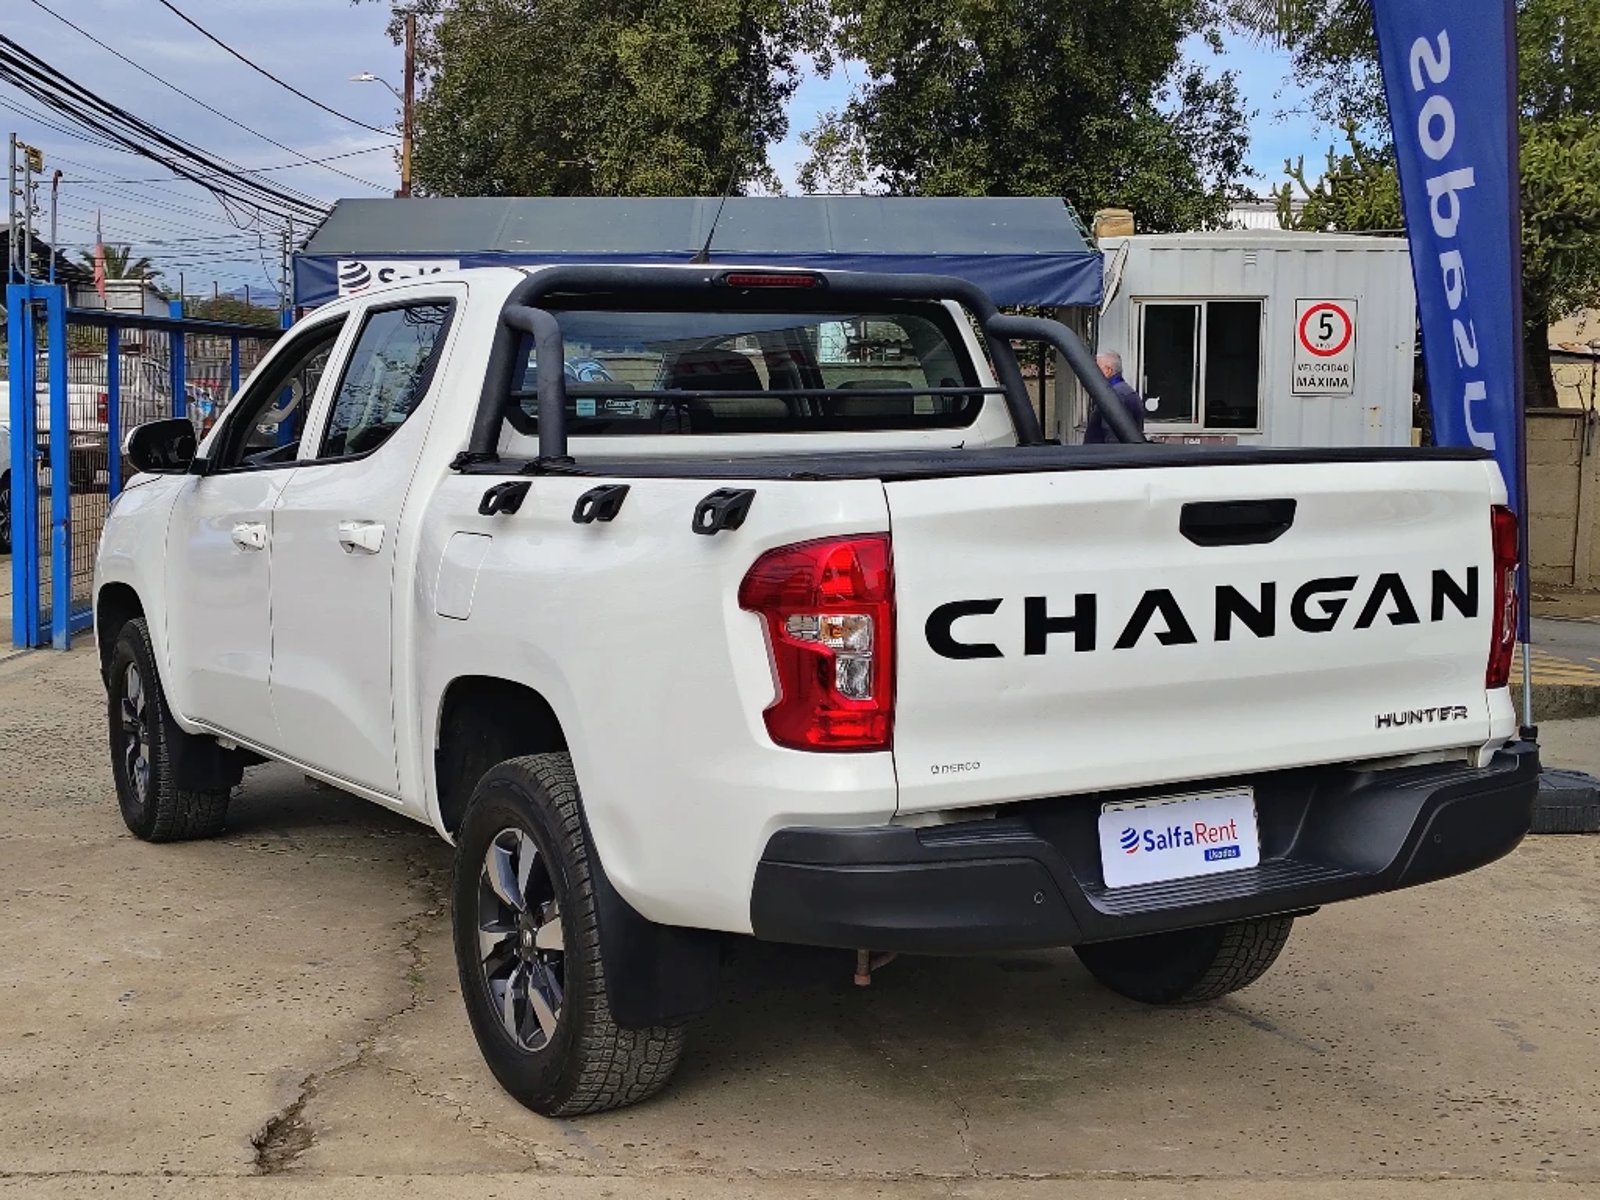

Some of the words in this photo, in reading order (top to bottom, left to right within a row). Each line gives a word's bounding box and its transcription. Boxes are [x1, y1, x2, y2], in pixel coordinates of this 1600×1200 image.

[1318, 313, 1333, 340] 5
[1298, 363, 1349, 372] VELOCIDAD
[1296, 374, 1349, 388] MÁXIMA
[924, 566, 1479, 660] CHANGAN
[1375, 705, 1467, 728] HUNTER
[1143, 818, 1238, 851] SalfaRent
